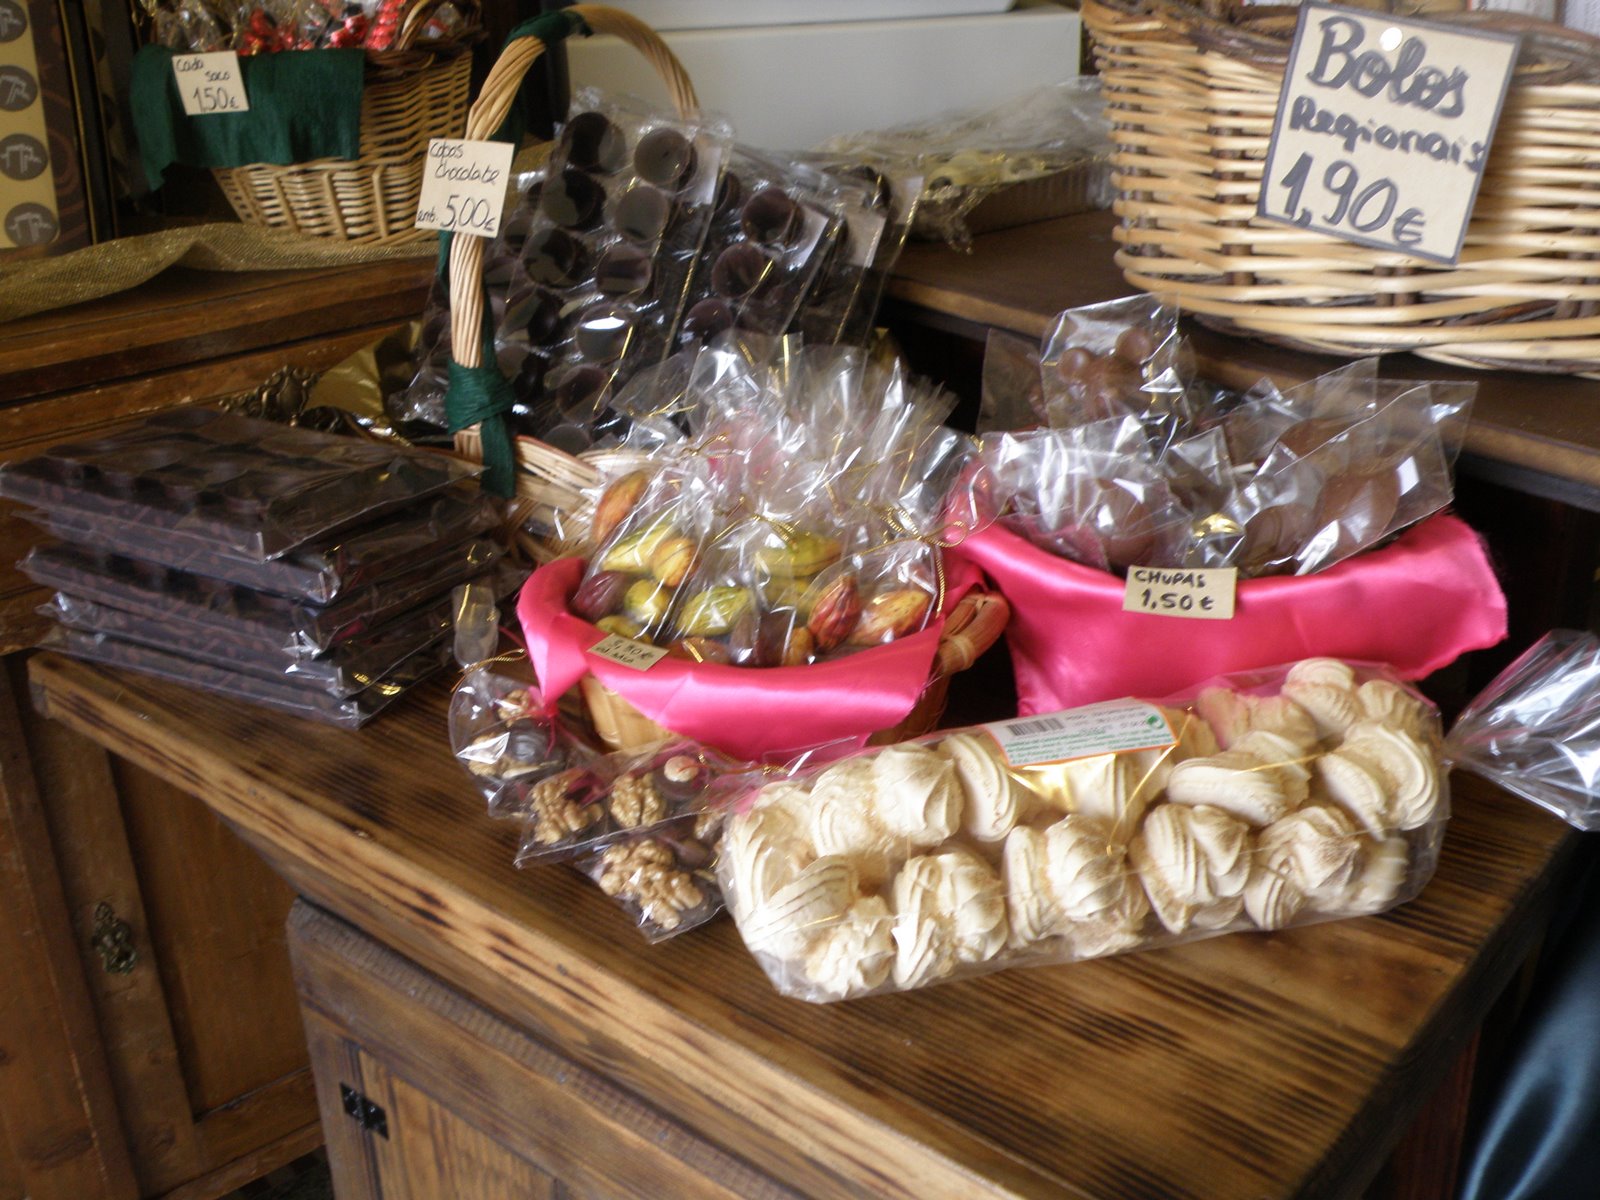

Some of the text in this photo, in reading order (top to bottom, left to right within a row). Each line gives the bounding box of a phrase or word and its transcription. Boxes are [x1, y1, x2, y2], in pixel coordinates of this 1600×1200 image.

[1305, 15, 1469, 119] Bolos
[1289, 95, 1488, 173] Regionais
[440, 194, 496, 232] 5,00€
[1280, 151, 1426, 246] 1,90€
[1134, 569, 1206, 588] CHUPAS
